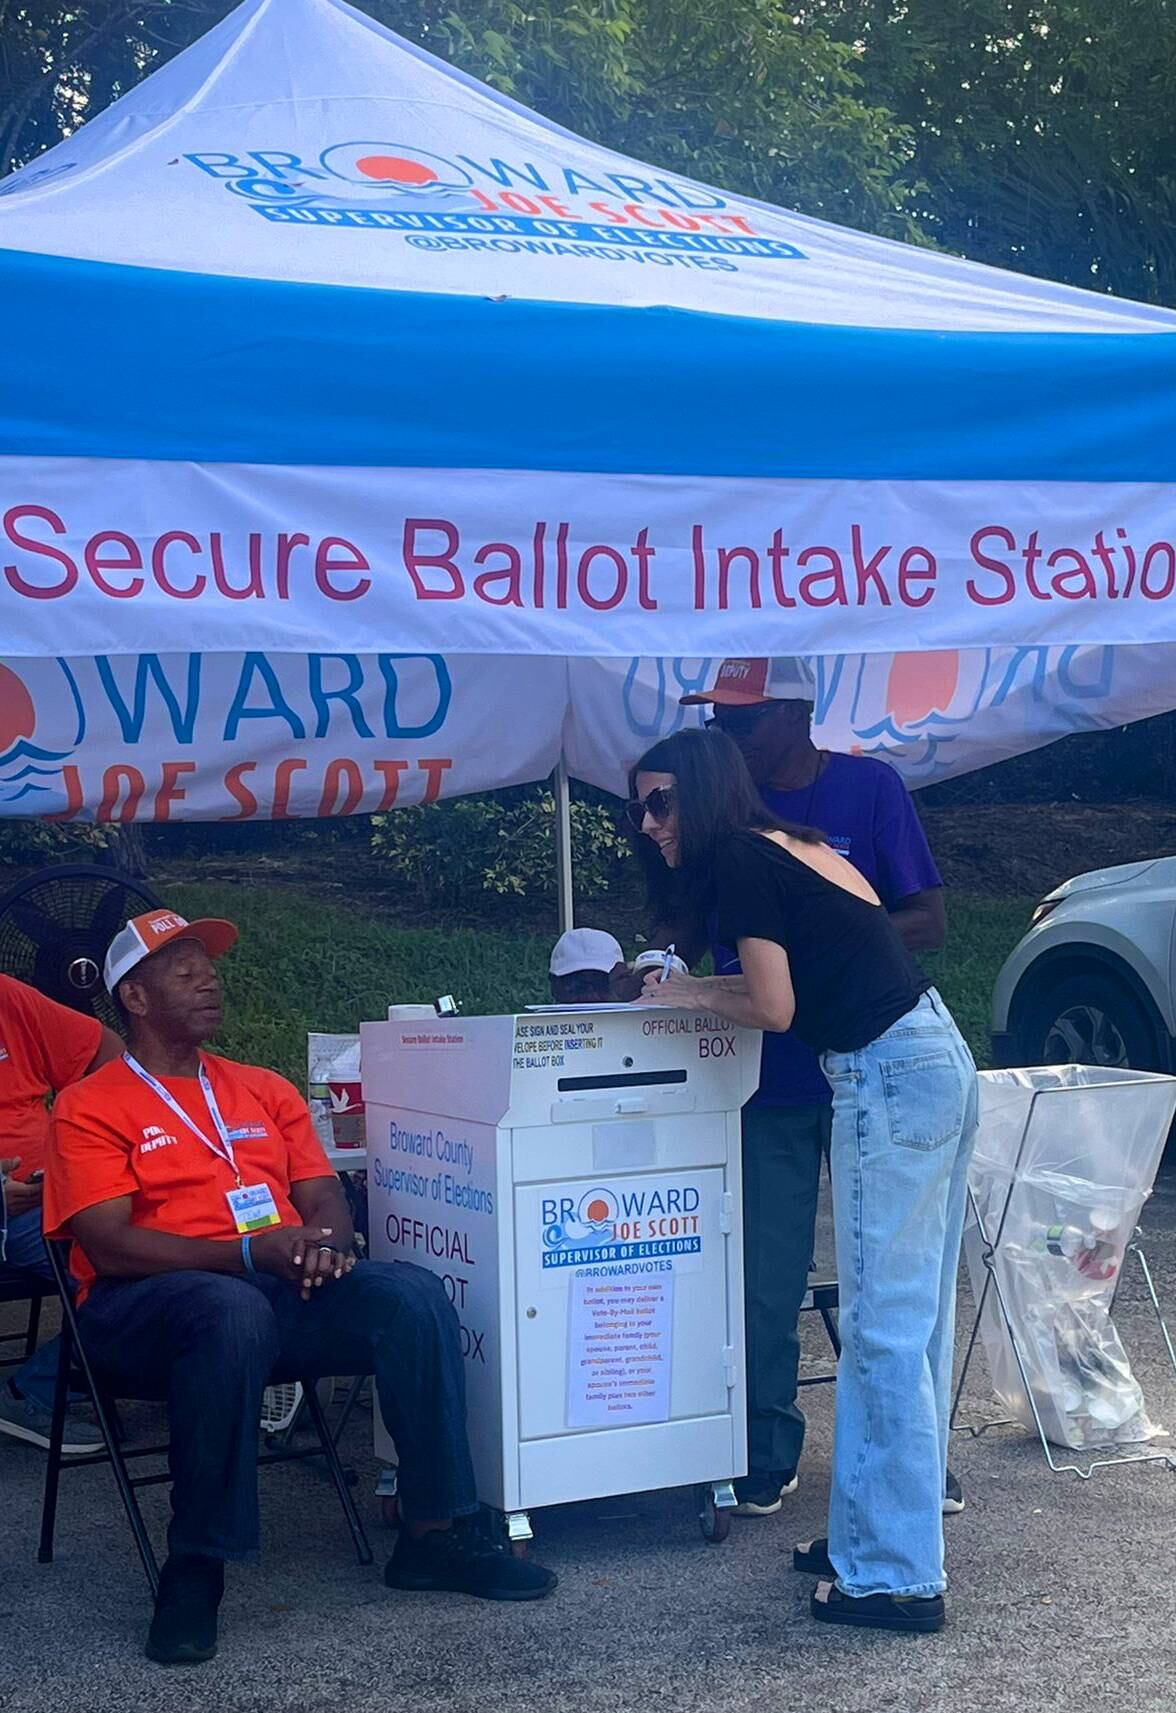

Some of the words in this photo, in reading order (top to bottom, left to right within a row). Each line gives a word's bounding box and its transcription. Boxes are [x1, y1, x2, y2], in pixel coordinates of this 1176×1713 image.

[182, 140, 727, 210] BROWARD
[470, 188, 583, 220] JOE
[589, 201, 759, 235] SCOTT
[264, 206, 523, 233] SUPERVISOR
[537, 220, 578, 238] OF
[600, 226, 796, 257] ELECTIONS
[404, 233, 739, 272] @BROWARDVOTES
[3, 504, 372, 601] Secure
[403, 517, 658, 610] Ballot
[692, 523, 937, 610] Intake
[965, 525, 1176, 607] Statio
[42, 761, 197, 824] JOE
[220, 758, 453, 821] SCOTT
[530, 1024, 545, 1037] SIGN
[546, 1023, 559, 1036] AND
[560, 1023, 576, 1035] SEAL
[576, 1022, 594, 1034] YOUR
[539, 1039, 563, 1052] BEFORE
[564, 1037, 597, 1050] INSERTING
[642, 1019, 692, 1036] OFFICIAL
[698, 1036, 736, 1058] BOX
[512, 1057, 525, 1069] THE
[526, 1056, 550, 1068] BALLOT
[551, 1055, 565, 1067] BOX
[389, 1121, 433, 1158] Broward
[435, 1130, 474, 1175] County
[374, 1158, 429, 1196] Supervisor
[431, 1173, 442, 1201] of
[444, 1174, 494, 1215] Elections
[542, 1187, 700, 1226] BROWARD
[385, 1213, 475, 1265] OFFICIAL
[611, 1221, 641, 1242] JOE
[648, 1215, 700, 1238] SCOTT
[544, 1247, 617, 1266] SUPERVISOR
[620, 1245, 636, 1258] OF
[638, 1238, 700, 1256] ELECTIONS
[575, 1259, 673, 1278] @BROWARDVOTES
[459, 1325, 486, 1365] OX
